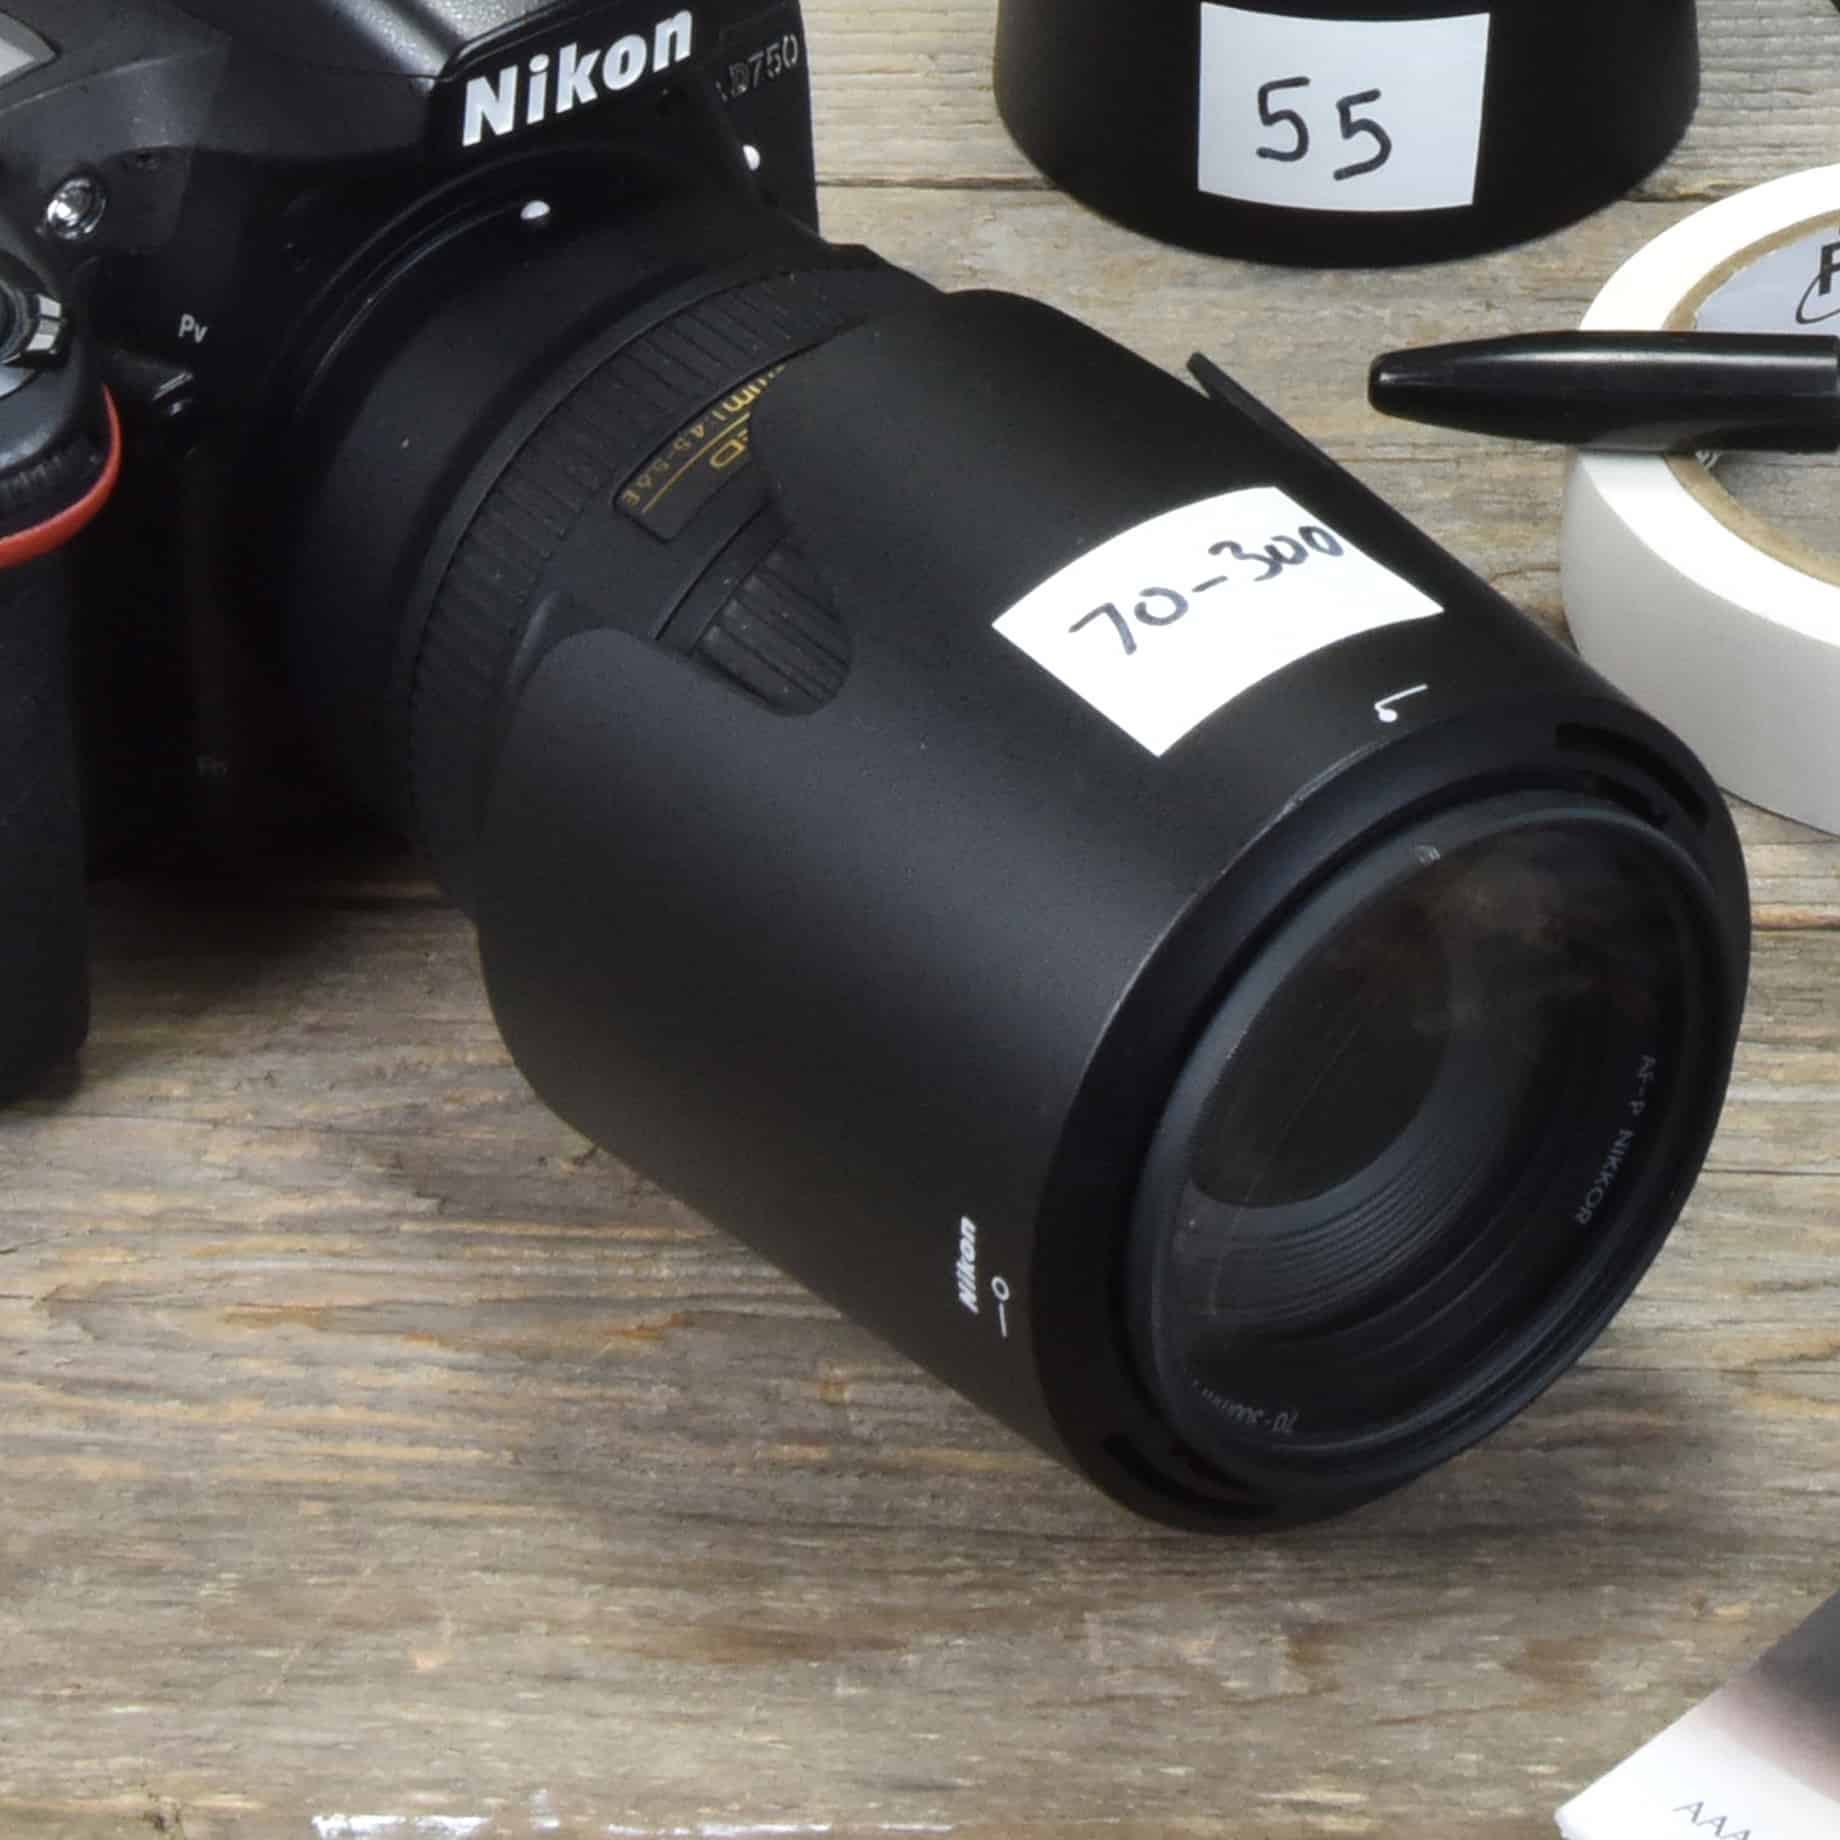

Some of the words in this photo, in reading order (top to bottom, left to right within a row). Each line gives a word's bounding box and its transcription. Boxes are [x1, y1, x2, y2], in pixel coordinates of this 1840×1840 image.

[462, 8, 695, 147] Nikon
[1255, 75, 1392, 182] 55
[1068, 525, 1345, 656] 70-300
[957, 1215, 980, 1315] Nikon
